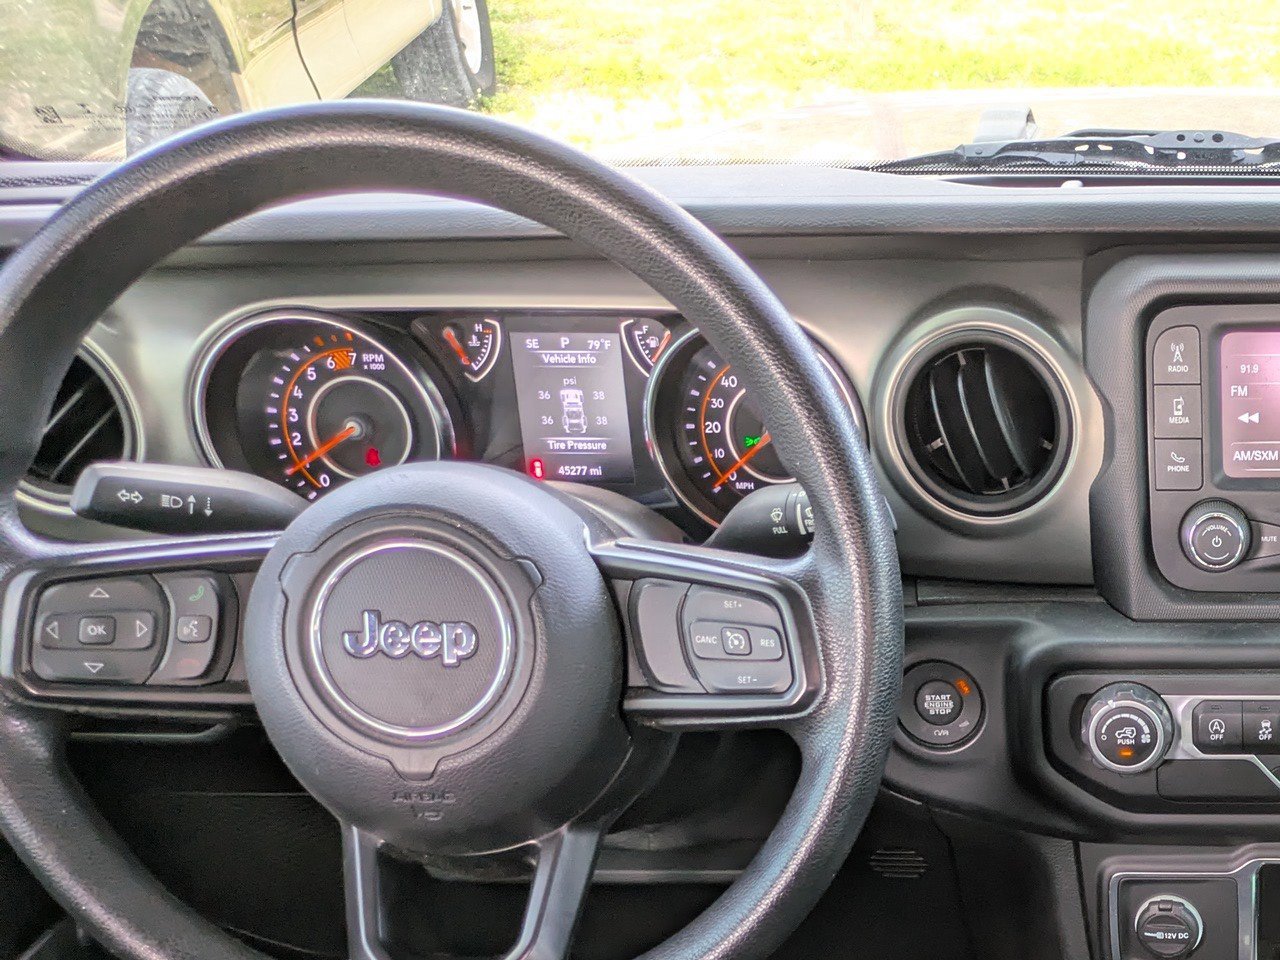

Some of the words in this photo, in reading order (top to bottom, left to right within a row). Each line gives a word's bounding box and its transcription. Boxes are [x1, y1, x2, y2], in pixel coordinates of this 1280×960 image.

[475, 323, 482, 332] H
[642, 325, 649, 334] F
[526, 338, 540, 349] SE
[561, 337, 570, 349] P
[326, 356, 336, 369] 6
[348, 352, 357, 365] 7
[362, 353, 385, 363] RPM
[542, 354, 576, 364] Vehicle
[577, 354, 597, 364] Info
[369, 363, 385, 371] 1000
[1167, 365, 1189, 373] RADIO
[1240, 364, 1259, 373] 91.9
[307, 367, 317, 381] 5
[563, 376, 577, 387] psi
[721, 376, 738, 388] 40
[293, 386, 303, 399] 4
[538, 390, 551, 401] 36
[592, 390, 605, 401] 38
[1230, 385, 1248, 397] FM
[710, 398, 724, 409] 30
[289, 408, 299, 422] 3
[1169, 416, 1190, 424] MEDIA
[541, 416, 554, 426] 36
[595, 416, 608, 426] 38
[705, 422, 721, 434] 20
[292, 432, 302, 446] 2
[547, 440, 566, 450] Tire
[567, 440, 607, 451] Pressure
[714, 449, 725, 459] 10
[1233, 450, 1279, 461] AM/SXM
[558, 466, 587, 476] 45277
[589, 466, 602, 476] mi
[1167, 465, 1190, 473] PHONE
[320, 475, 330, 487] 0
[735, 482, 754, 490] MPH
[772, 525, 788, 534] PULL
[1205, 523, 1229, 533] VOLUME
[1261, 535, 1278, 543] MUTE
[87, 624, 107, 636] OK
[343, 609, 479, 668] Jeep
[695, 635, 718, 644] CANC
[760, 638, 775, 647] RES
[924, 700, 955, 709] ENGINE
[1210, 733, 1224, 741] OFF
[1258, 733, 1272, 741] OFF
